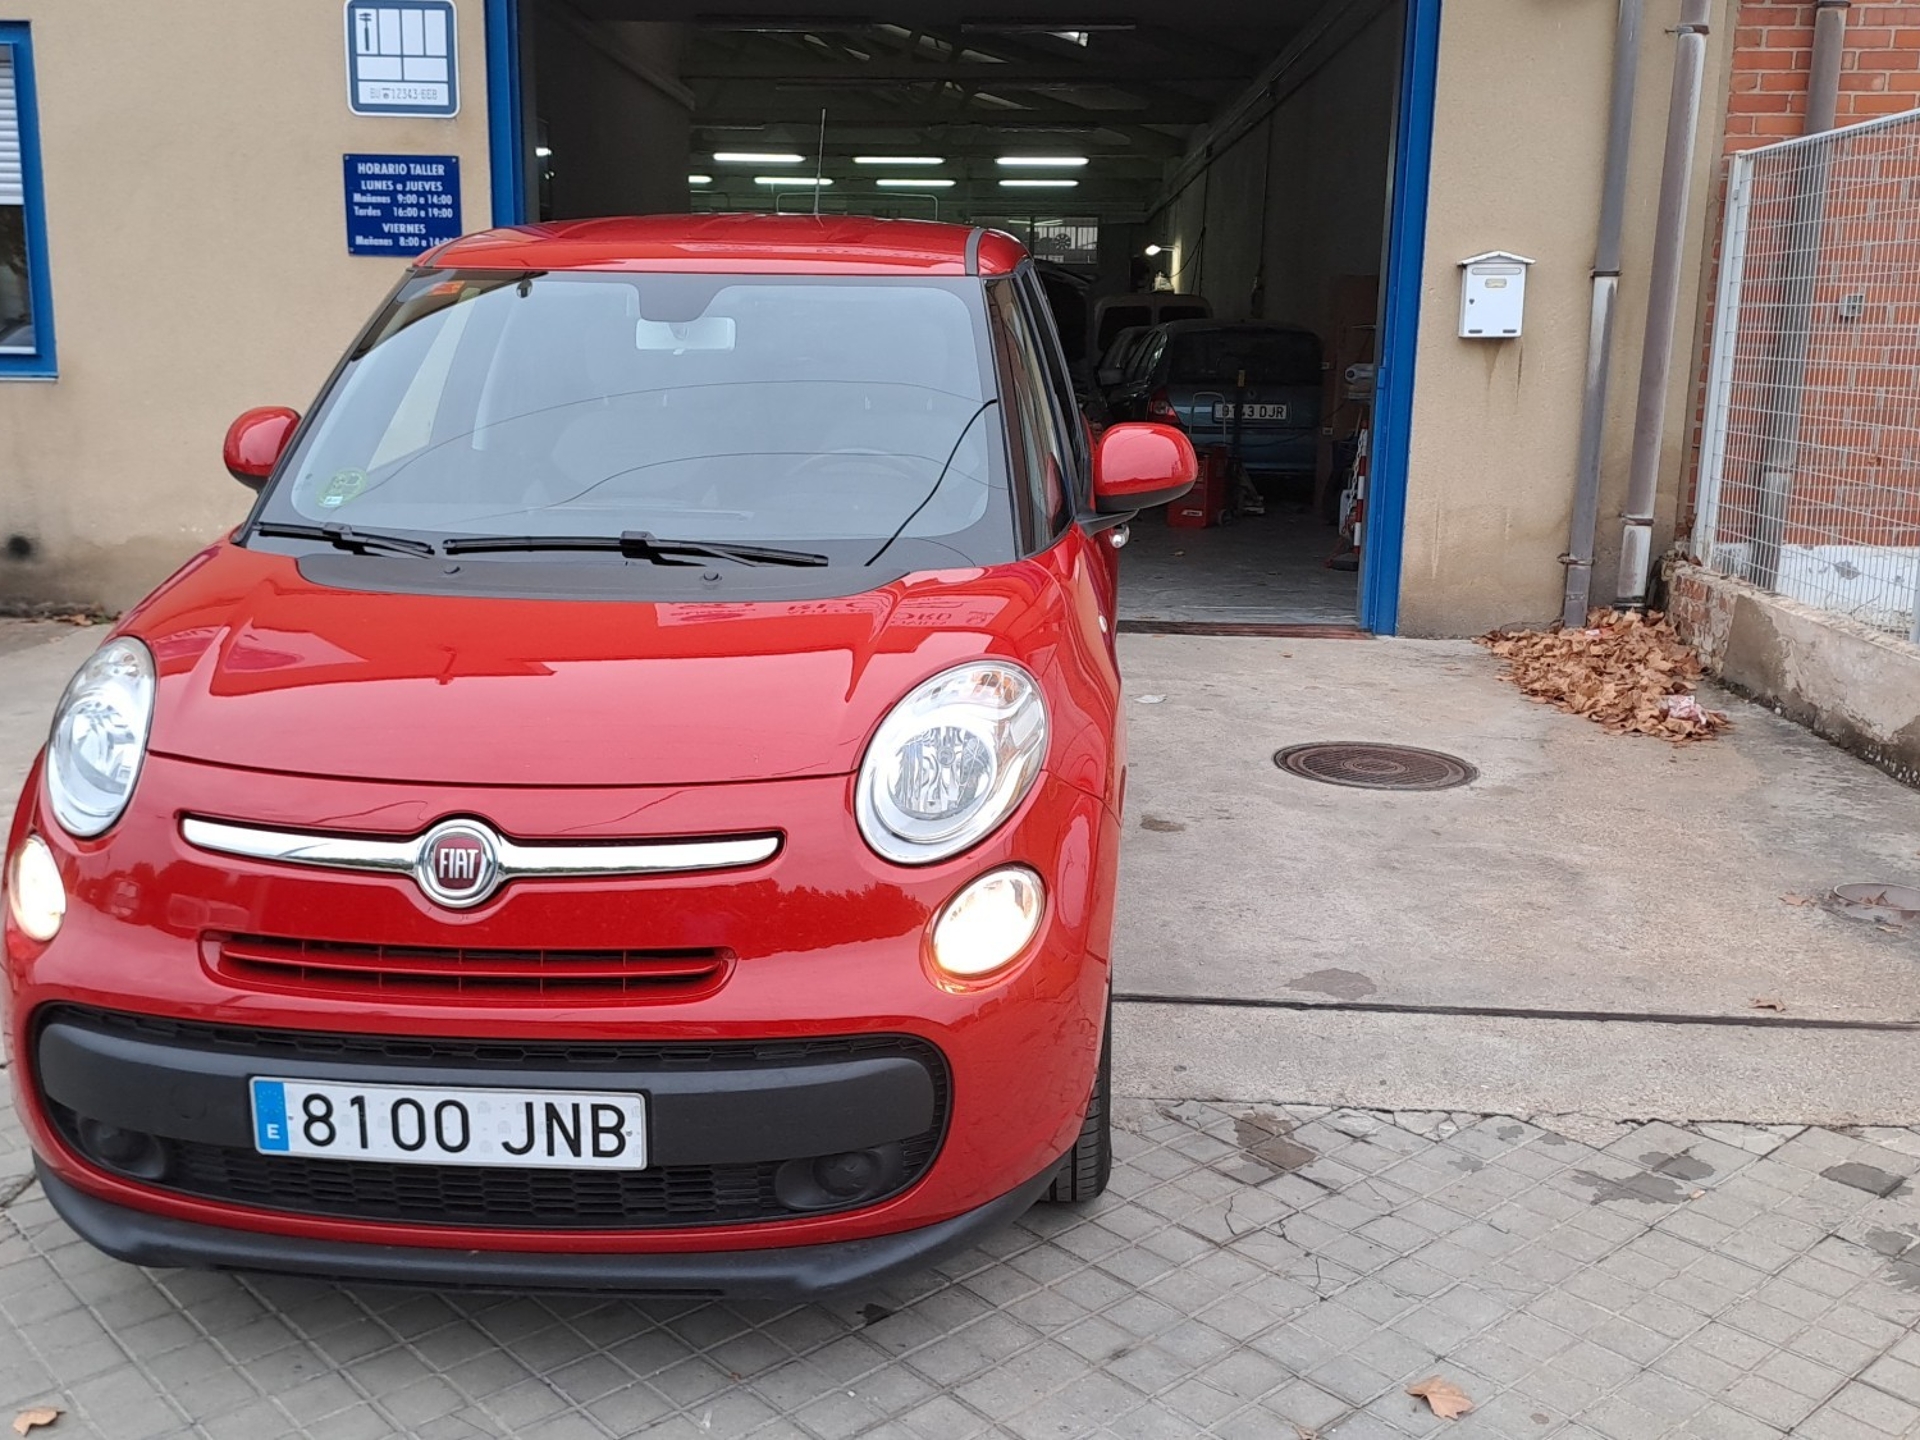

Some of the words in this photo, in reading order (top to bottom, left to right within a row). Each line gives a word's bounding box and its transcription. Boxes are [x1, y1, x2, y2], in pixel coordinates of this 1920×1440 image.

[357, 163, 407, 175] HORARIO
[409, 164, 445, 176] TALLER
[361, 180, 394, 191] LUNES
[405, 181, 443, 192] JUEVES
[353, 193, 391, 203] Mañanas
[397, 194, 418, 204] 9:00
[427, 194, 453, 205] 14:00
[353, 206, 382, 216] Tardes
[393, 207, 418, 217] 16:00
[428, 208, 453, 218] 19:00
[382, 223, 426, 234] VIERNES
[355, 235, 393, 246] Mañanas
[399, 236, 419, 247] 8:00
[429, 237, 454, 247] 14:
[1259, 405, 1285, 419] DJR
[439, 848, 479, 879] FIAT
[266, 1124, 280, 1140] E
[302, 1093, 470, 1154] 8100
[501, 1101, 626, 1159] JNB
